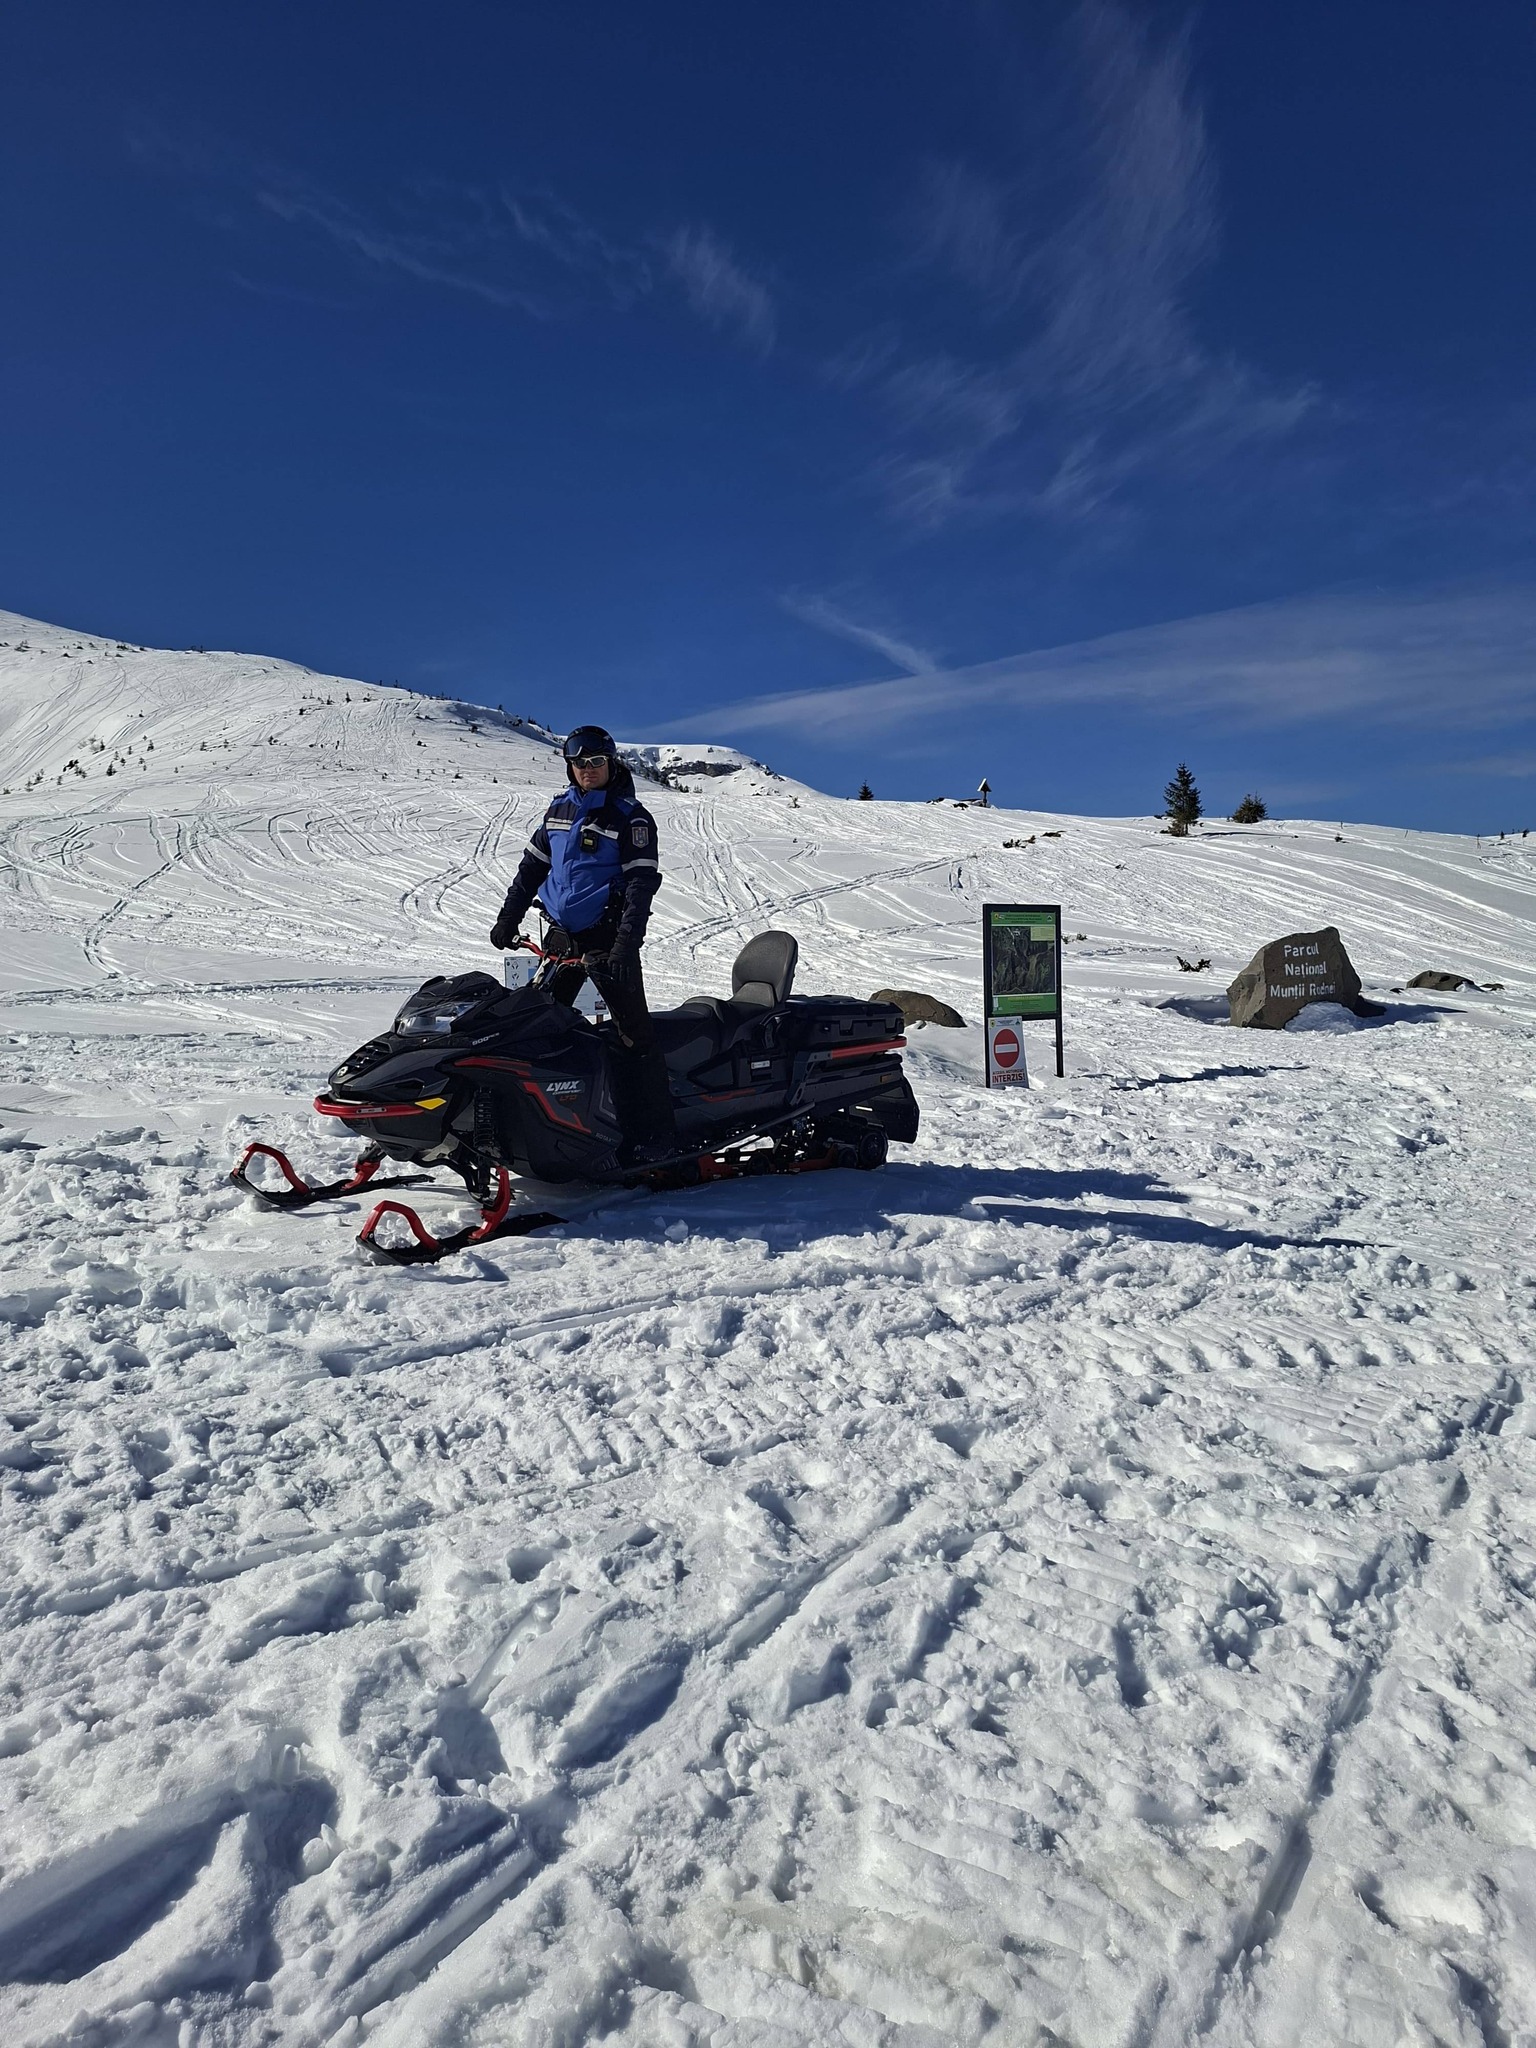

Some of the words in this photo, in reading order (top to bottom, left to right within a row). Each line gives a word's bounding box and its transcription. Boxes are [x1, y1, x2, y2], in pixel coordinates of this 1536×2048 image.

[1284, 942, 1319, 957] Parcul
[1309, 981, 1336, 996] Rodnei
[992, 1073, 1026, 1083] INTERZIS!
[546, 1080, 580, 1092] LYNX
